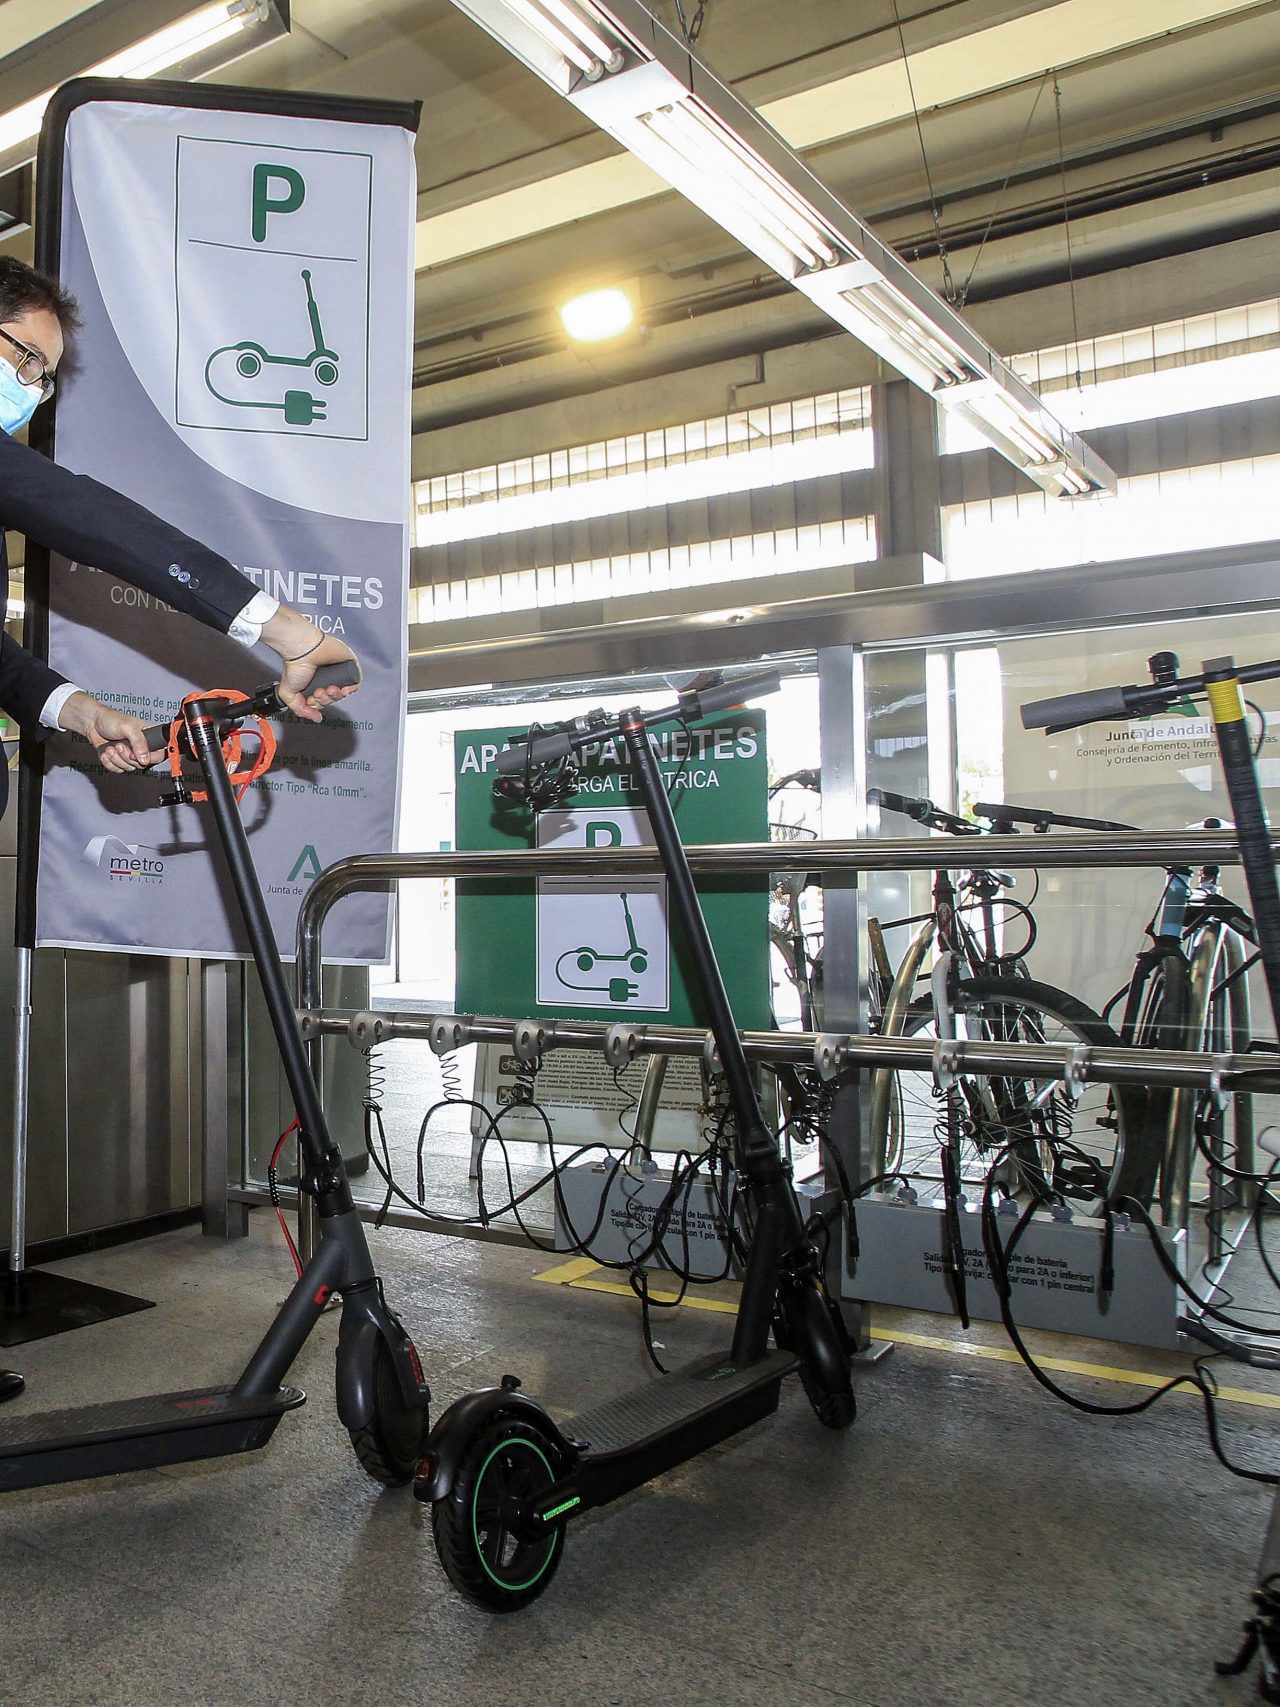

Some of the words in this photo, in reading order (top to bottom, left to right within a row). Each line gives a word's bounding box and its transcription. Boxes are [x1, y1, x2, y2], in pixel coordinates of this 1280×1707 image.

[251, 162, 306, 243] P
[110, 586, 149, 609] CON
[153, 697, 164, 709] de
[140, 710, 152, 721] del
[1105, 728, 1144, 742] Junta
[1146, 726, 1164, 738] de
[1167, 723, 1216, 737] Andalu
[459, 725, 759, 775] APAPATNETES
[1128, 744, 1140, 754] de
[1141, 740, 1191, 753] Fomento,
[283, 755, 299, 767] por
[334, 759, 374, 772] amarilla.
[1106, 758, 1113, 767] y
[1114, 753, 1171, 765] Ordenación
[1173, 751, 1190, 761] del
[70, 760, 106, 775] Recarg
[250, 780, 283, 792] onector
[286, 781, 306, 795] Tipo
[618, 770, 721, 793] ELTRICA
[110, 857, 164, 873] metro
[109, 875, 163, 885] SEVILLA
[266, 884, 291, 895] Junta
[292, 886, 303, 896] de
[611, 1218, 624, 1228] Tipo
[704, 1232, 715, 1240] pin
[697, 1220, 707, 1230] 2A
[963, 1248, 986, 1258] gador
[1024, 1255, 1035, 1265] de
[924, 1262, 942, 1274] Tipo
[1021, 1278, 1038, 1286] con
[1040, 1278, 1045, 1287] 1
[1047, 1280, 1062, 1291] pin
[1063, 1283, 1095, 1294] central
[1016, 1266, 1035, 1277] para
[1037, 1267, 1049, 1278] 2A
